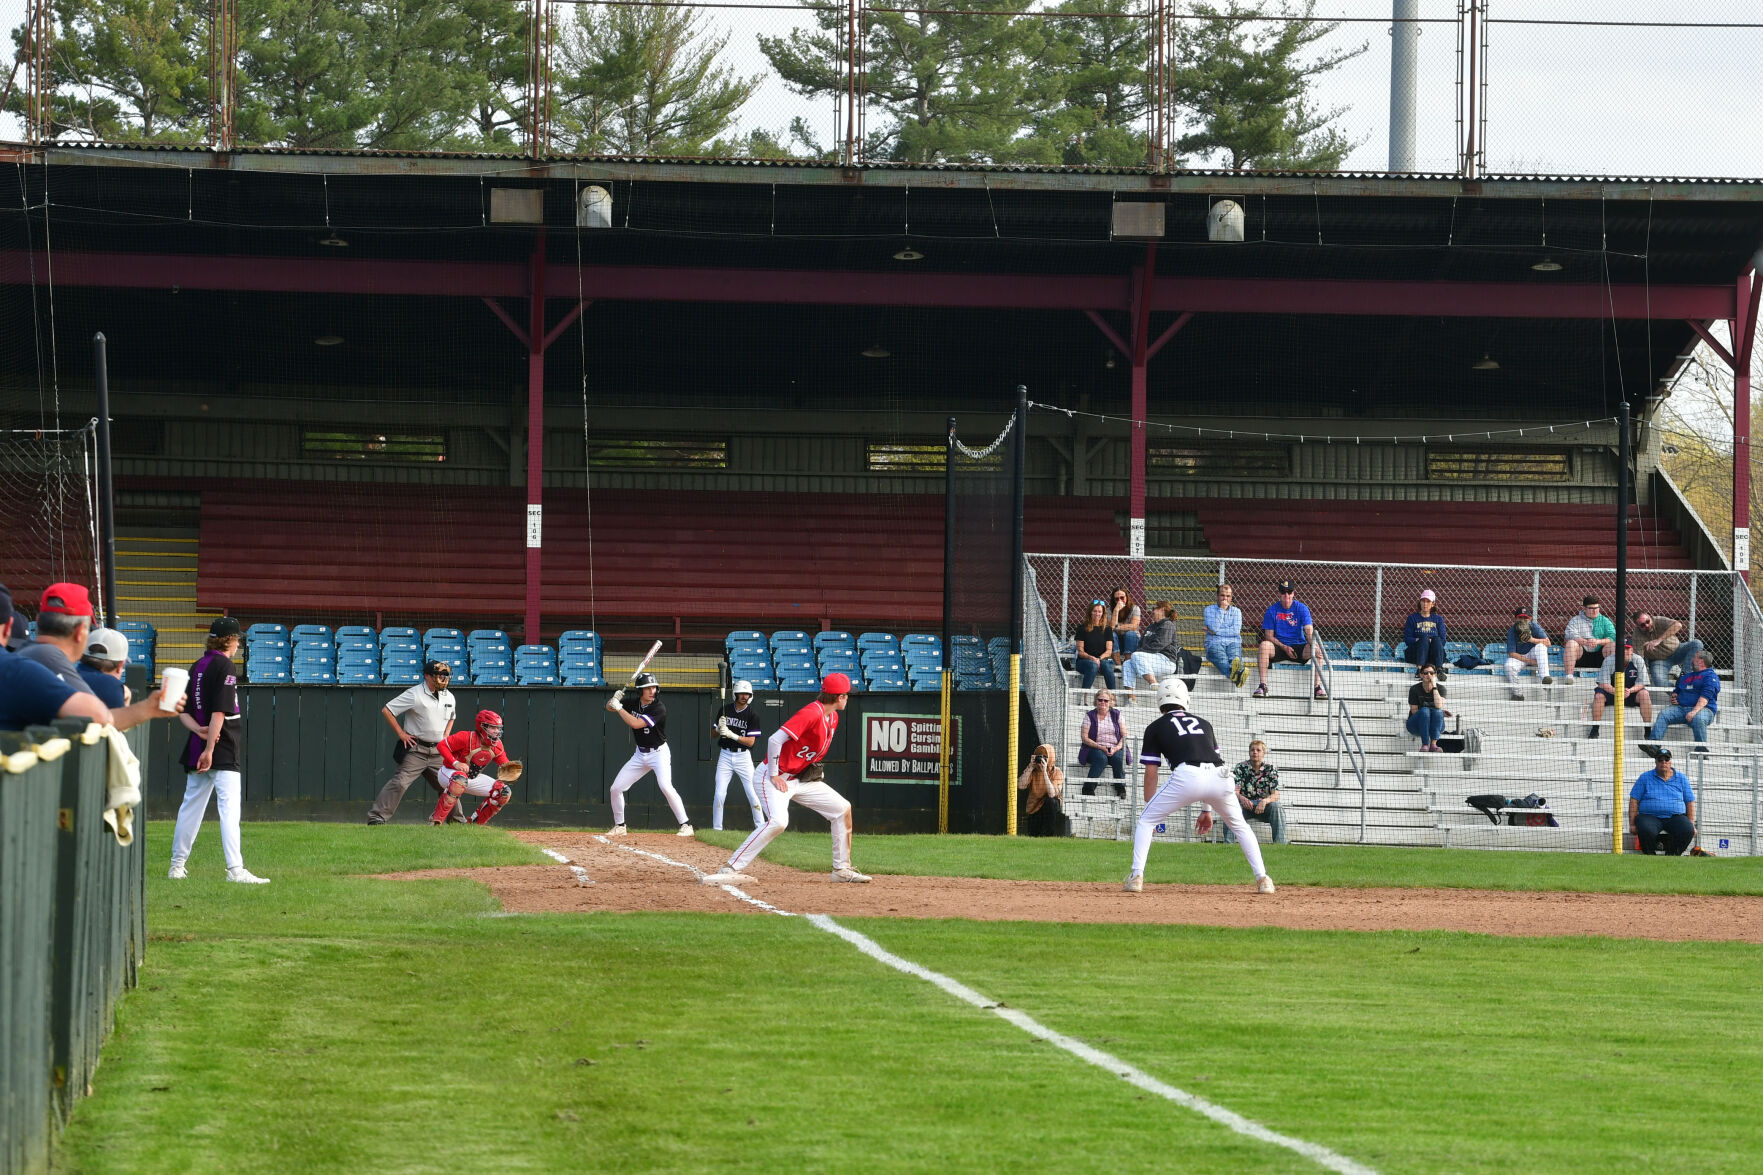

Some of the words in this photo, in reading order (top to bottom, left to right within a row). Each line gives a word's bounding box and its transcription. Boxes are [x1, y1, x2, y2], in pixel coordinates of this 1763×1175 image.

[727, 717, 748, 730] ENERALS
[911, 722, 942, 733] Spittin
[1170, 716, 1205, 736] 12
[871, 720, 908, 753] NO
[911, 733, 941, 743] Cursin
[796, 745, 817, 761] 24
[910, 743, 954, 755] Gambl
[870, 758, 900, 772] ALLOWED
[902, 759, 911, 773] BY
